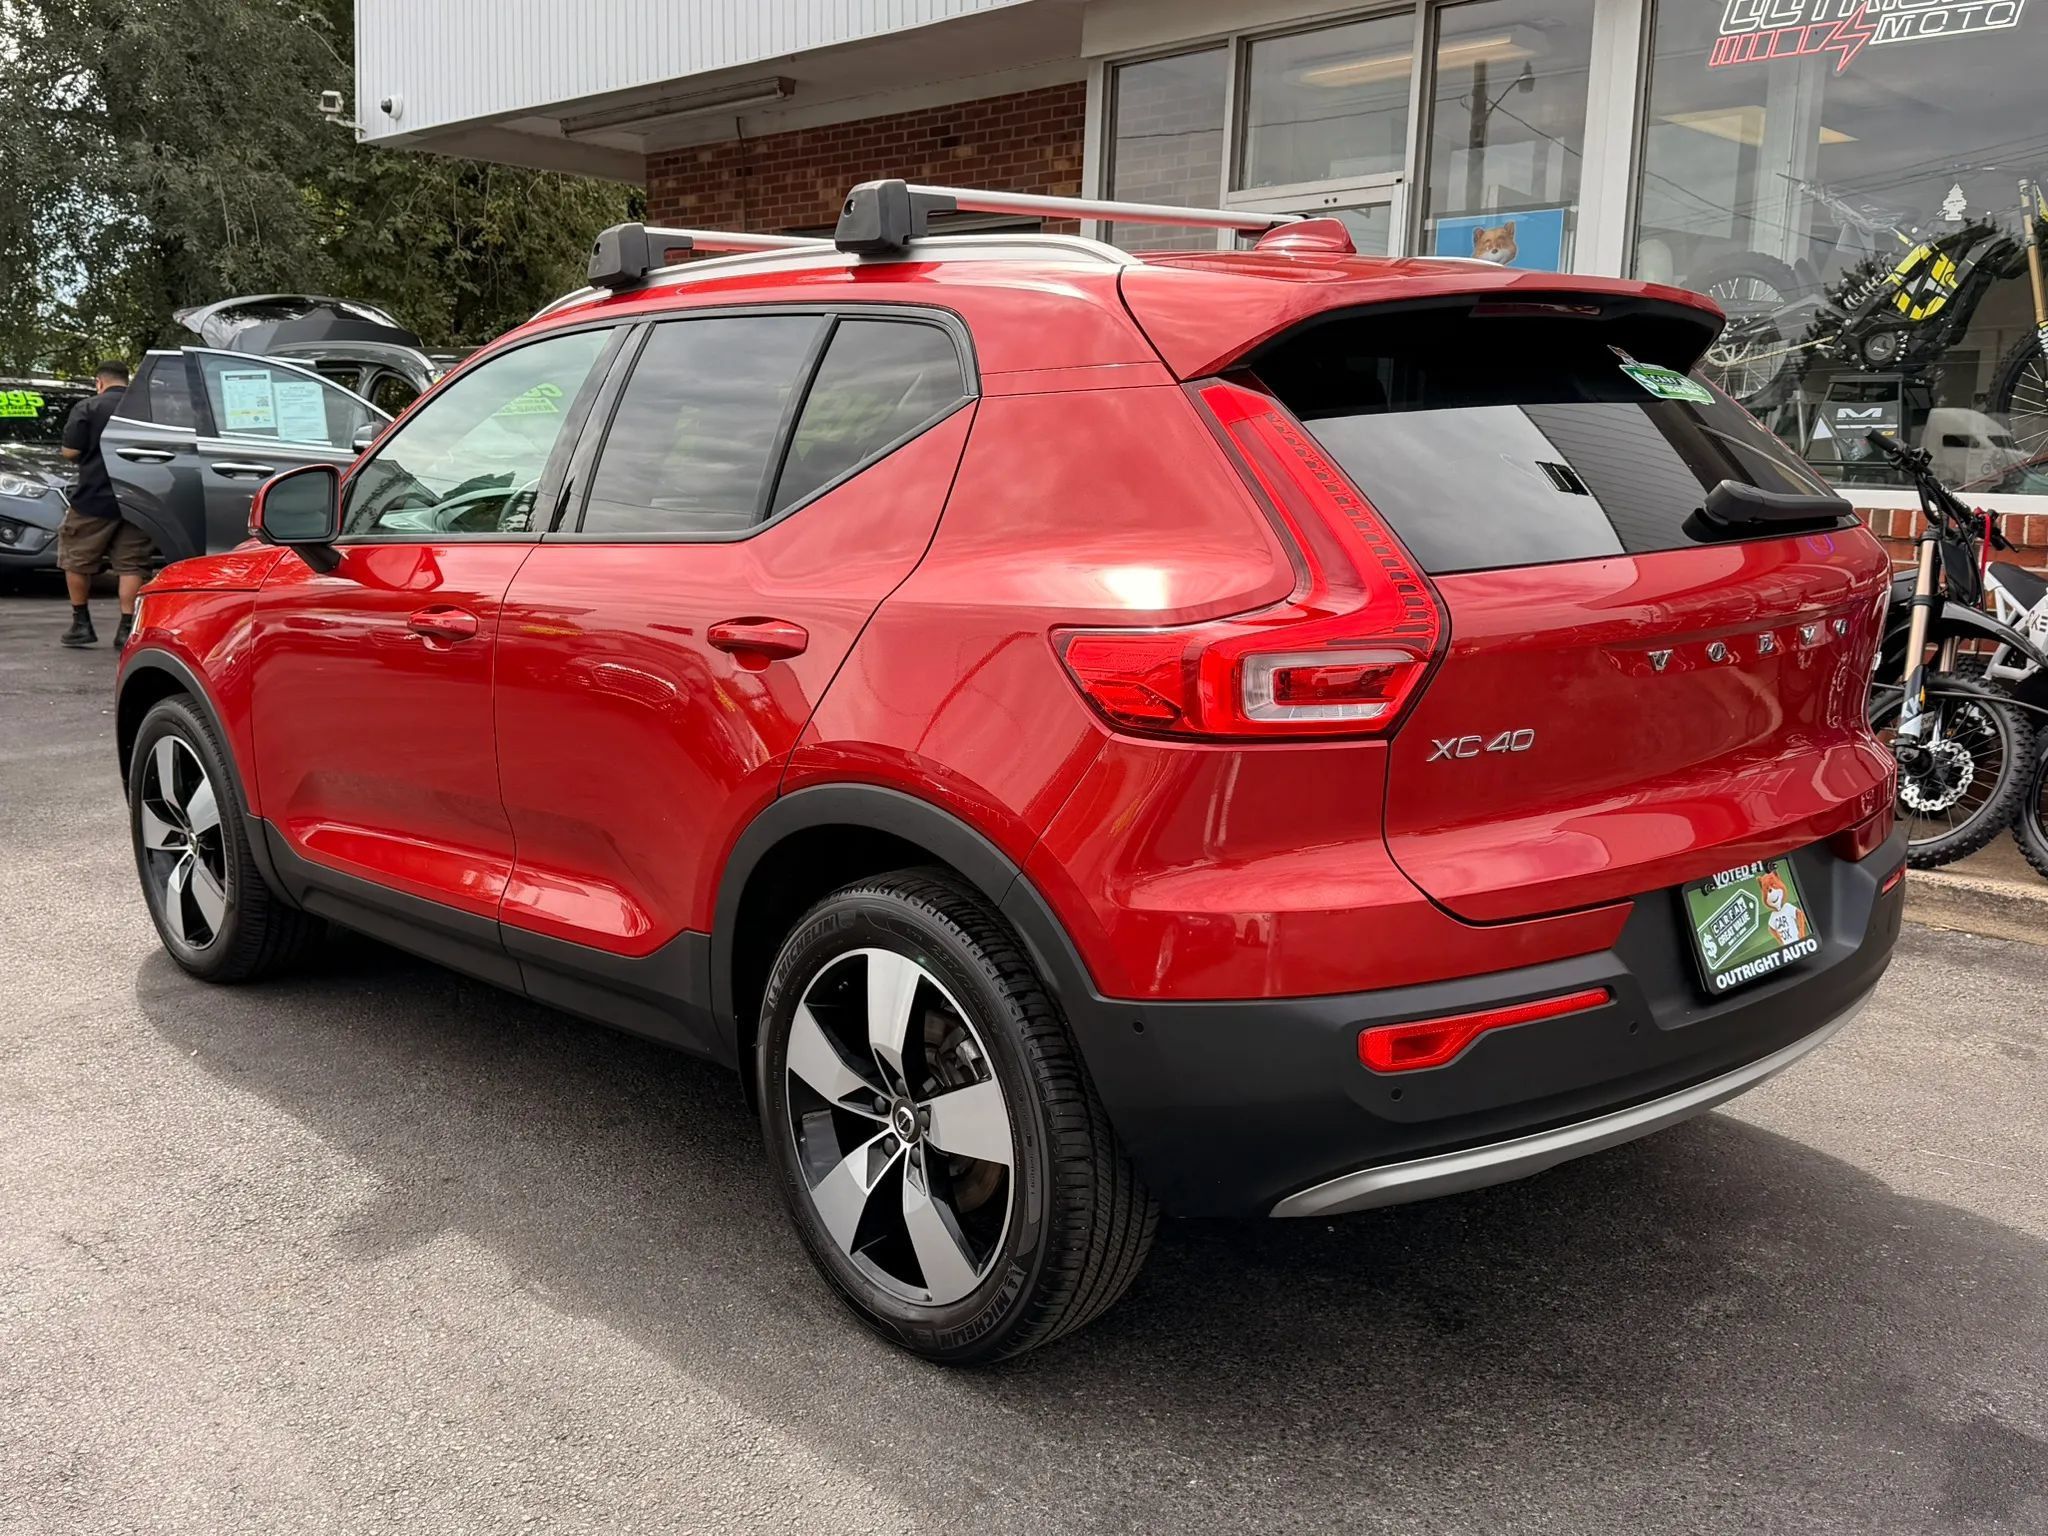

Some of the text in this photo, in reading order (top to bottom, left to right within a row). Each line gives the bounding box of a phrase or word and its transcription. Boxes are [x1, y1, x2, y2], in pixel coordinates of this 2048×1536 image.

[1878, 2, 2013, 40] MOTO
[1648, 618, 1849, 672] VOLVO
[1713, 864, 1749, 885] VOTED
[1713, 897, 1747, 935] CARFAX
[1716, 939, 1817, 988] OUTRIGHT AUTO
[938, 1287, 1012, 1350] MICHELIN
